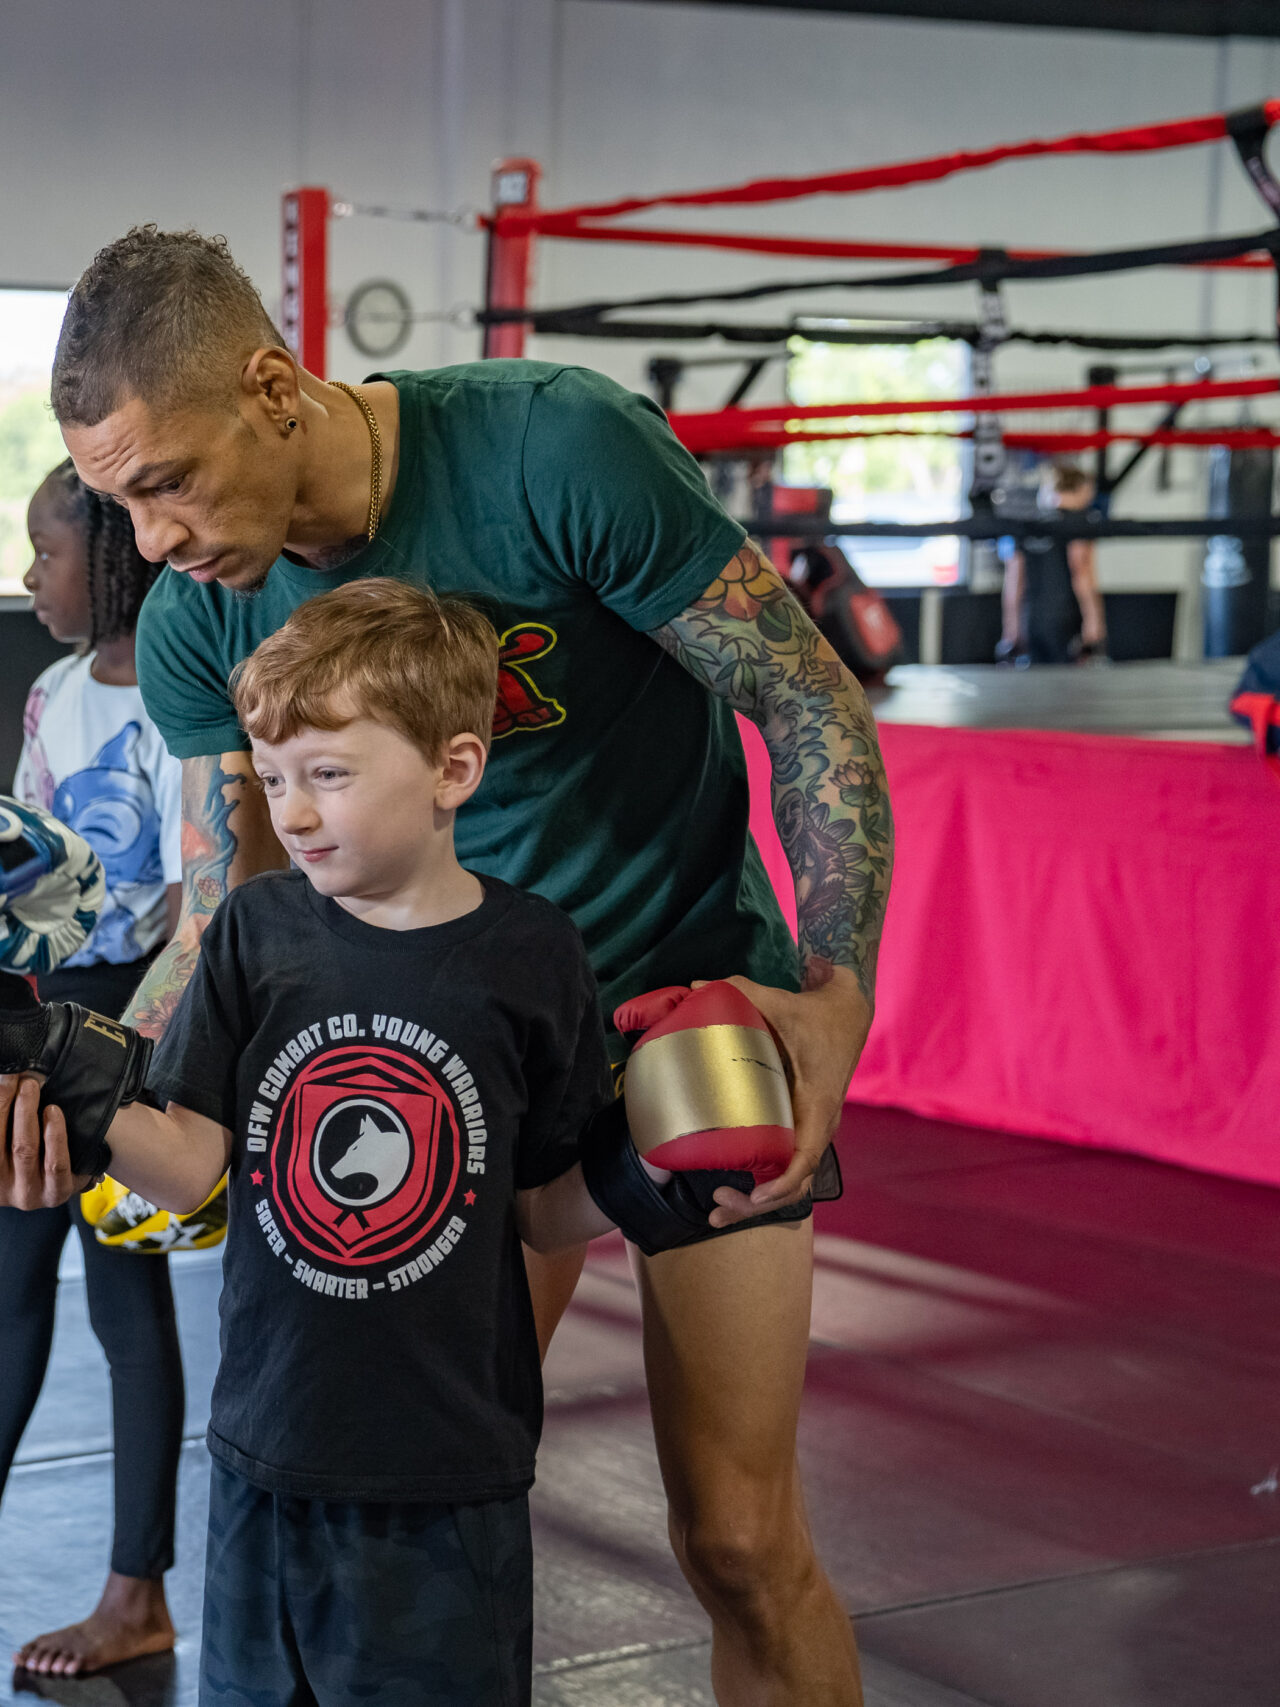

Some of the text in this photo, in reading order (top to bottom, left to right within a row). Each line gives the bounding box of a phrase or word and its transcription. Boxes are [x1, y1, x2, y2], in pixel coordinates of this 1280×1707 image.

[247, 1014, 487, 1174] DFW COMBAT CO. YOUNG WARRIORS
[255, 1199, 287, 1257] SAFER
[293, 1258, 369, 1299] SMARTER
[387, 1215, 467, 1292] STRONGER
